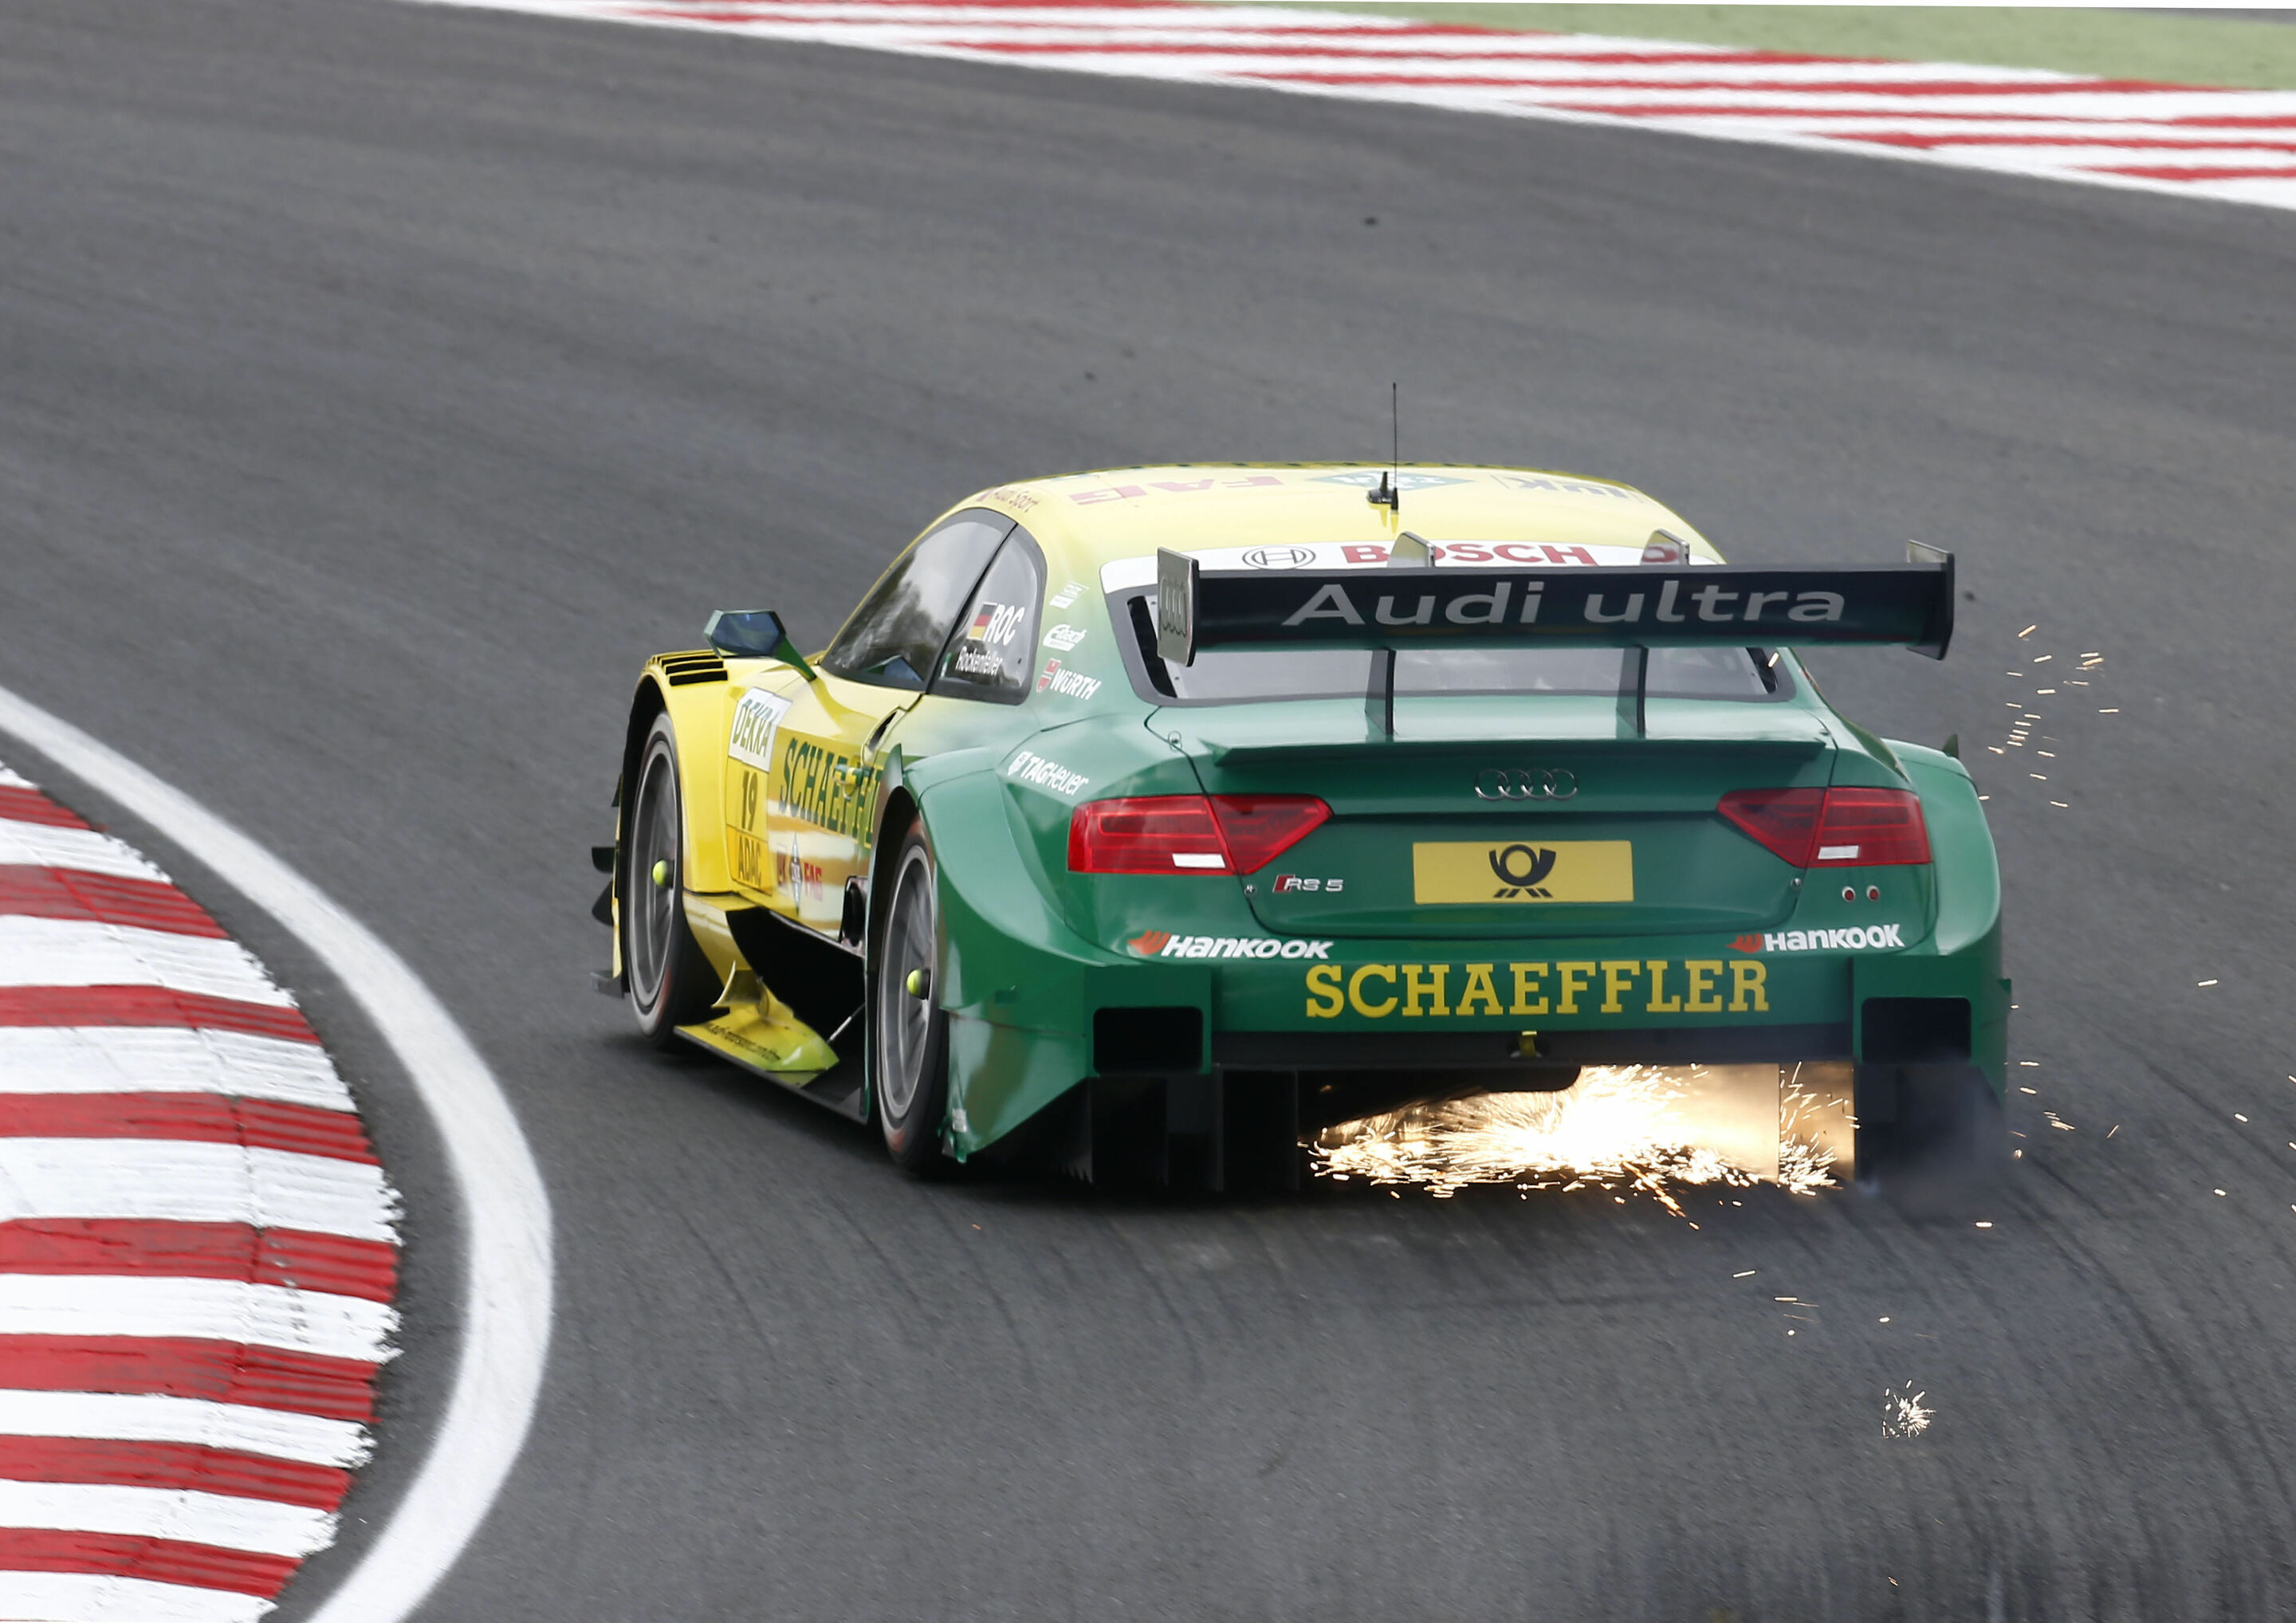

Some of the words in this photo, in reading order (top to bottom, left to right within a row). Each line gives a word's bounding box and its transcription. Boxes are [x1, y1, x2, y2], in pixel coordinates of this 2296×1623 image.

[1340, 544, 1599, 567] BSCH
[981, 603, 1025, 646] ROC
[1281, 581, 1545, 627] Audi
[1583, 580, 1846, 623] ultra
[732, 698, 780, 758] DEKRA
[741, 770, 758, 831] 19
[738, 835, 762, 887] ADAC
[1283, 878, 1322, 892] RS
[1325, 878, 1344, 893] 5
[1305, 959, 1770, 1020] SCHAEFFLER
